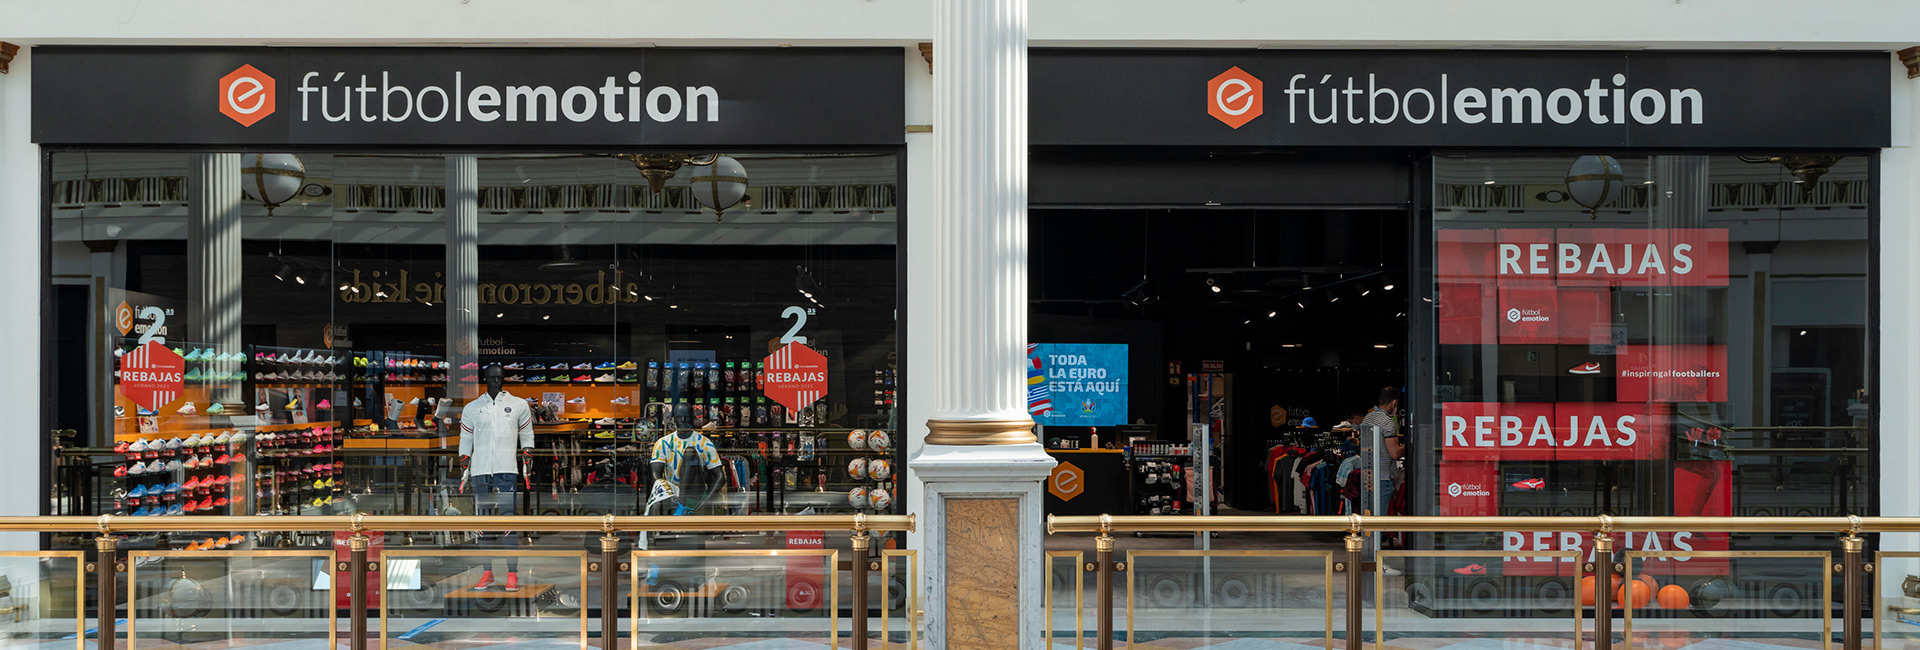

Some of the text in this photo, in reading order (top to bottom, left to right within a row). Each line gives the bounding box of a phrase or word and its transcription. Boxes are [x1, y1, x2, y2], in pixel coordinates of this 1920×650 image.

[1500, 243, 1693, 275] REBAJAS
[1049, 354, 1087, 366] TODA
[123, 371, 181, 383] REBAJAS
[767, 372, 825, 383] REBAJAS
[1048, 367, 1107, 379] LA EURO
[1048, 378, 1120, 396] ESTÁ AQUÍ
[1445, 415, 1637, 447] REBAJAS
